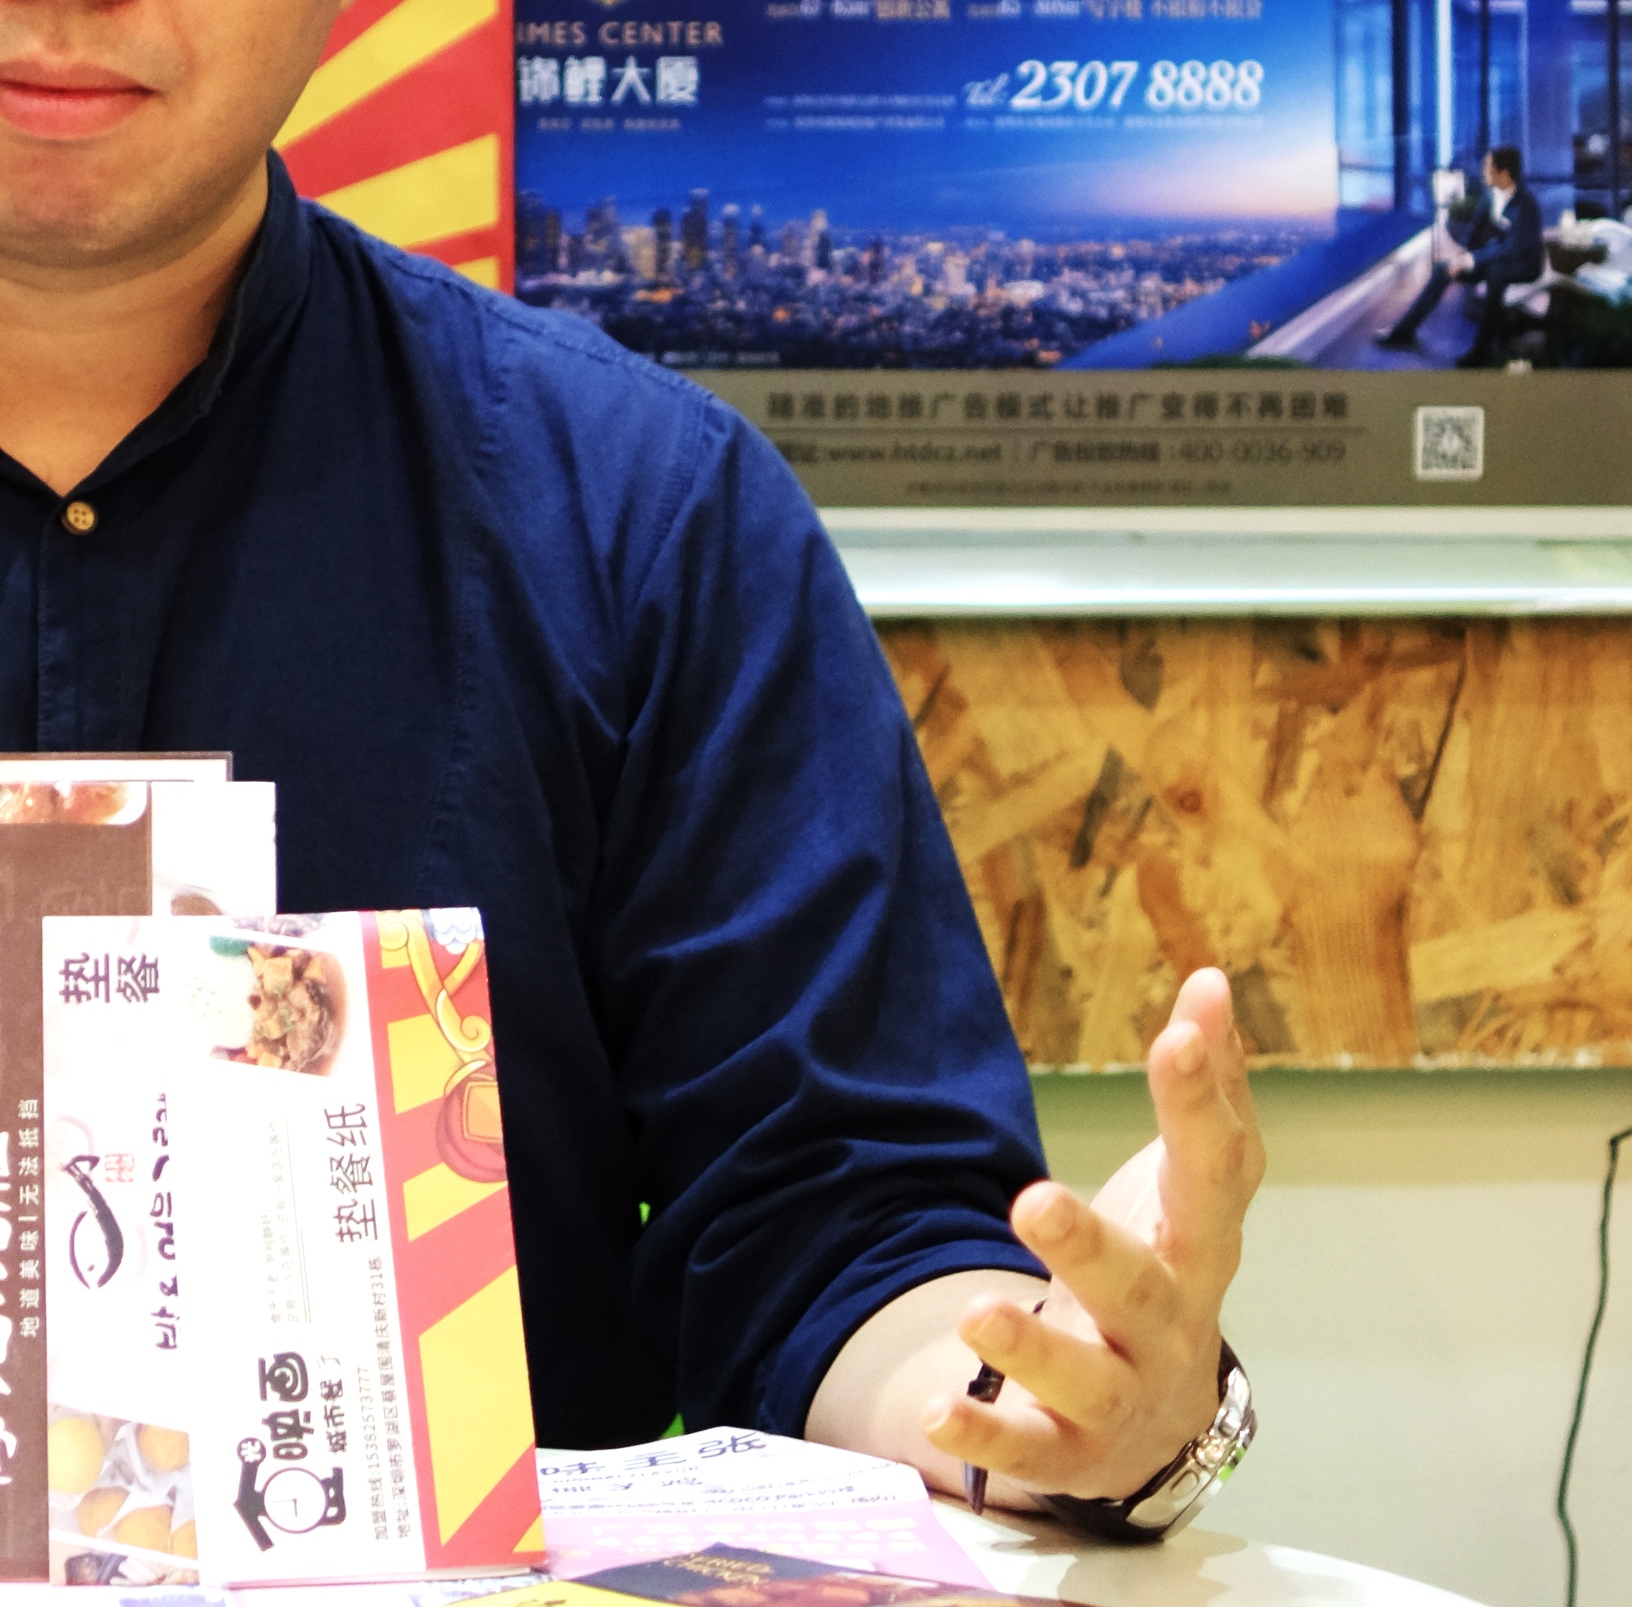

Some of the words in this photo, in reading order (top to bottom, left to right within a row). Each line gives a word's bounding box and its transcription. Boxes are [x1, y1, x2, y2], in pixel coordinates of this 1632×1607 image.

[516, 20, 589, 47] IMES
[598, 20, 724, 47] CENTER
[1011, 59, 1140, 112] 2307
[1145, 59, 1265, 112] 8888
[334, 1103, 378, 1244] 垫餐纸
